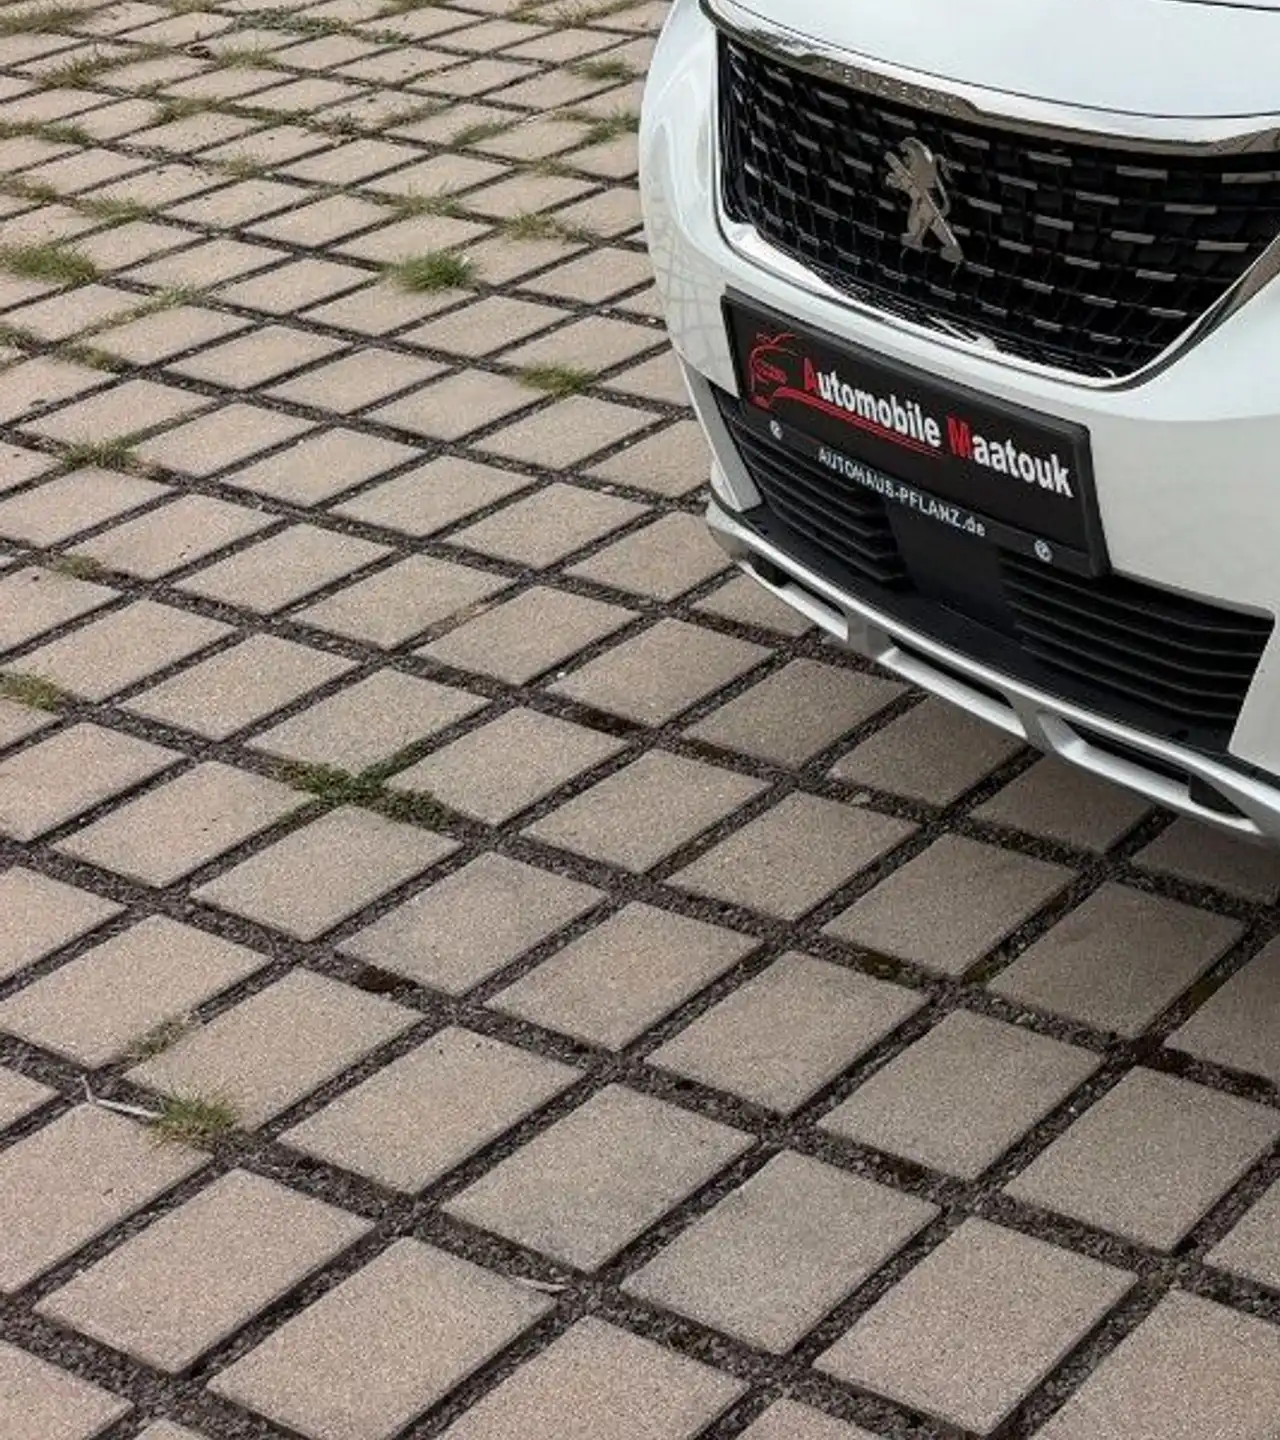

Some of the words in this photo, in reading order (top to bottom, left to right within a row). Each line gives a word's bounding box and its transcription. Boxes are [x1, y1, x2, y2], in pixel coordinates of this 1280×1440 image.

[803, 357, 942, 448] Automobile
[946, 414, 1075, 499] Maatouk
[818, 446, 987, 538] AUTOHAUS-PFLANZ.de
